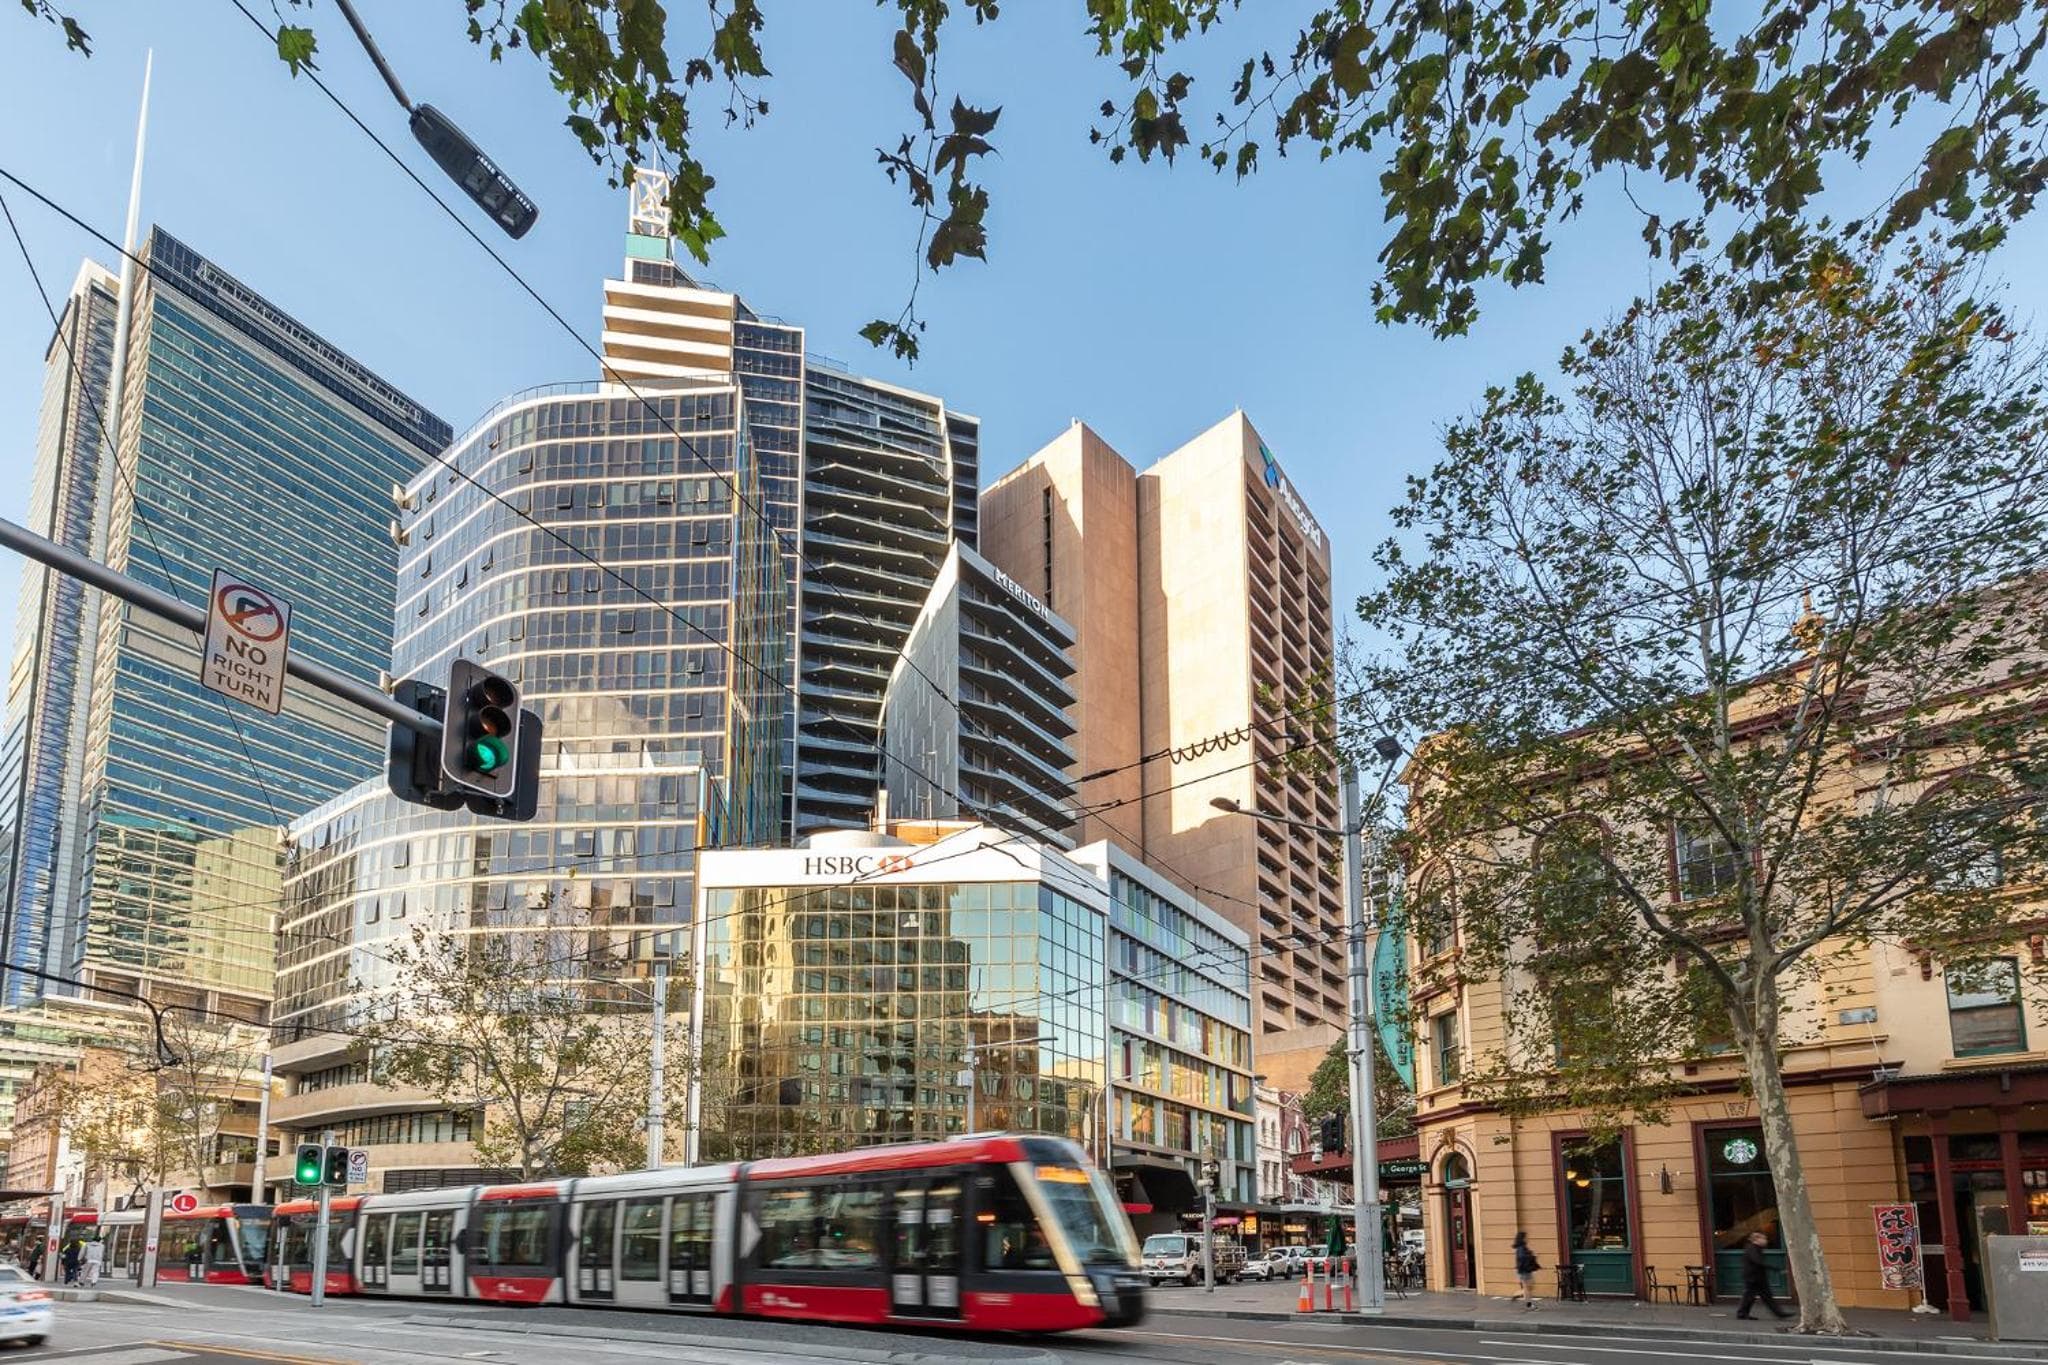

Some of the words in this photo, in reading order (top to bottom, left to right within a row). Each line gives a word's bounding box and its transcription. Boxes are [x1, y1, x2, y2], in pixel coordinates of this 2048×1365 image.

[994, 567, 1049, 620] MERITON
[225, 634, 267, 666] NO
[213, 653, 274, 688] RIGHT
[215, 671, 271, 704] TURN
[805, 856, 873, 875] HSBC
[1390, 1164, 1418, 1174] George
[1418, 1163, 1427, 1172] St
[180, 1196, 192, 1210] L
